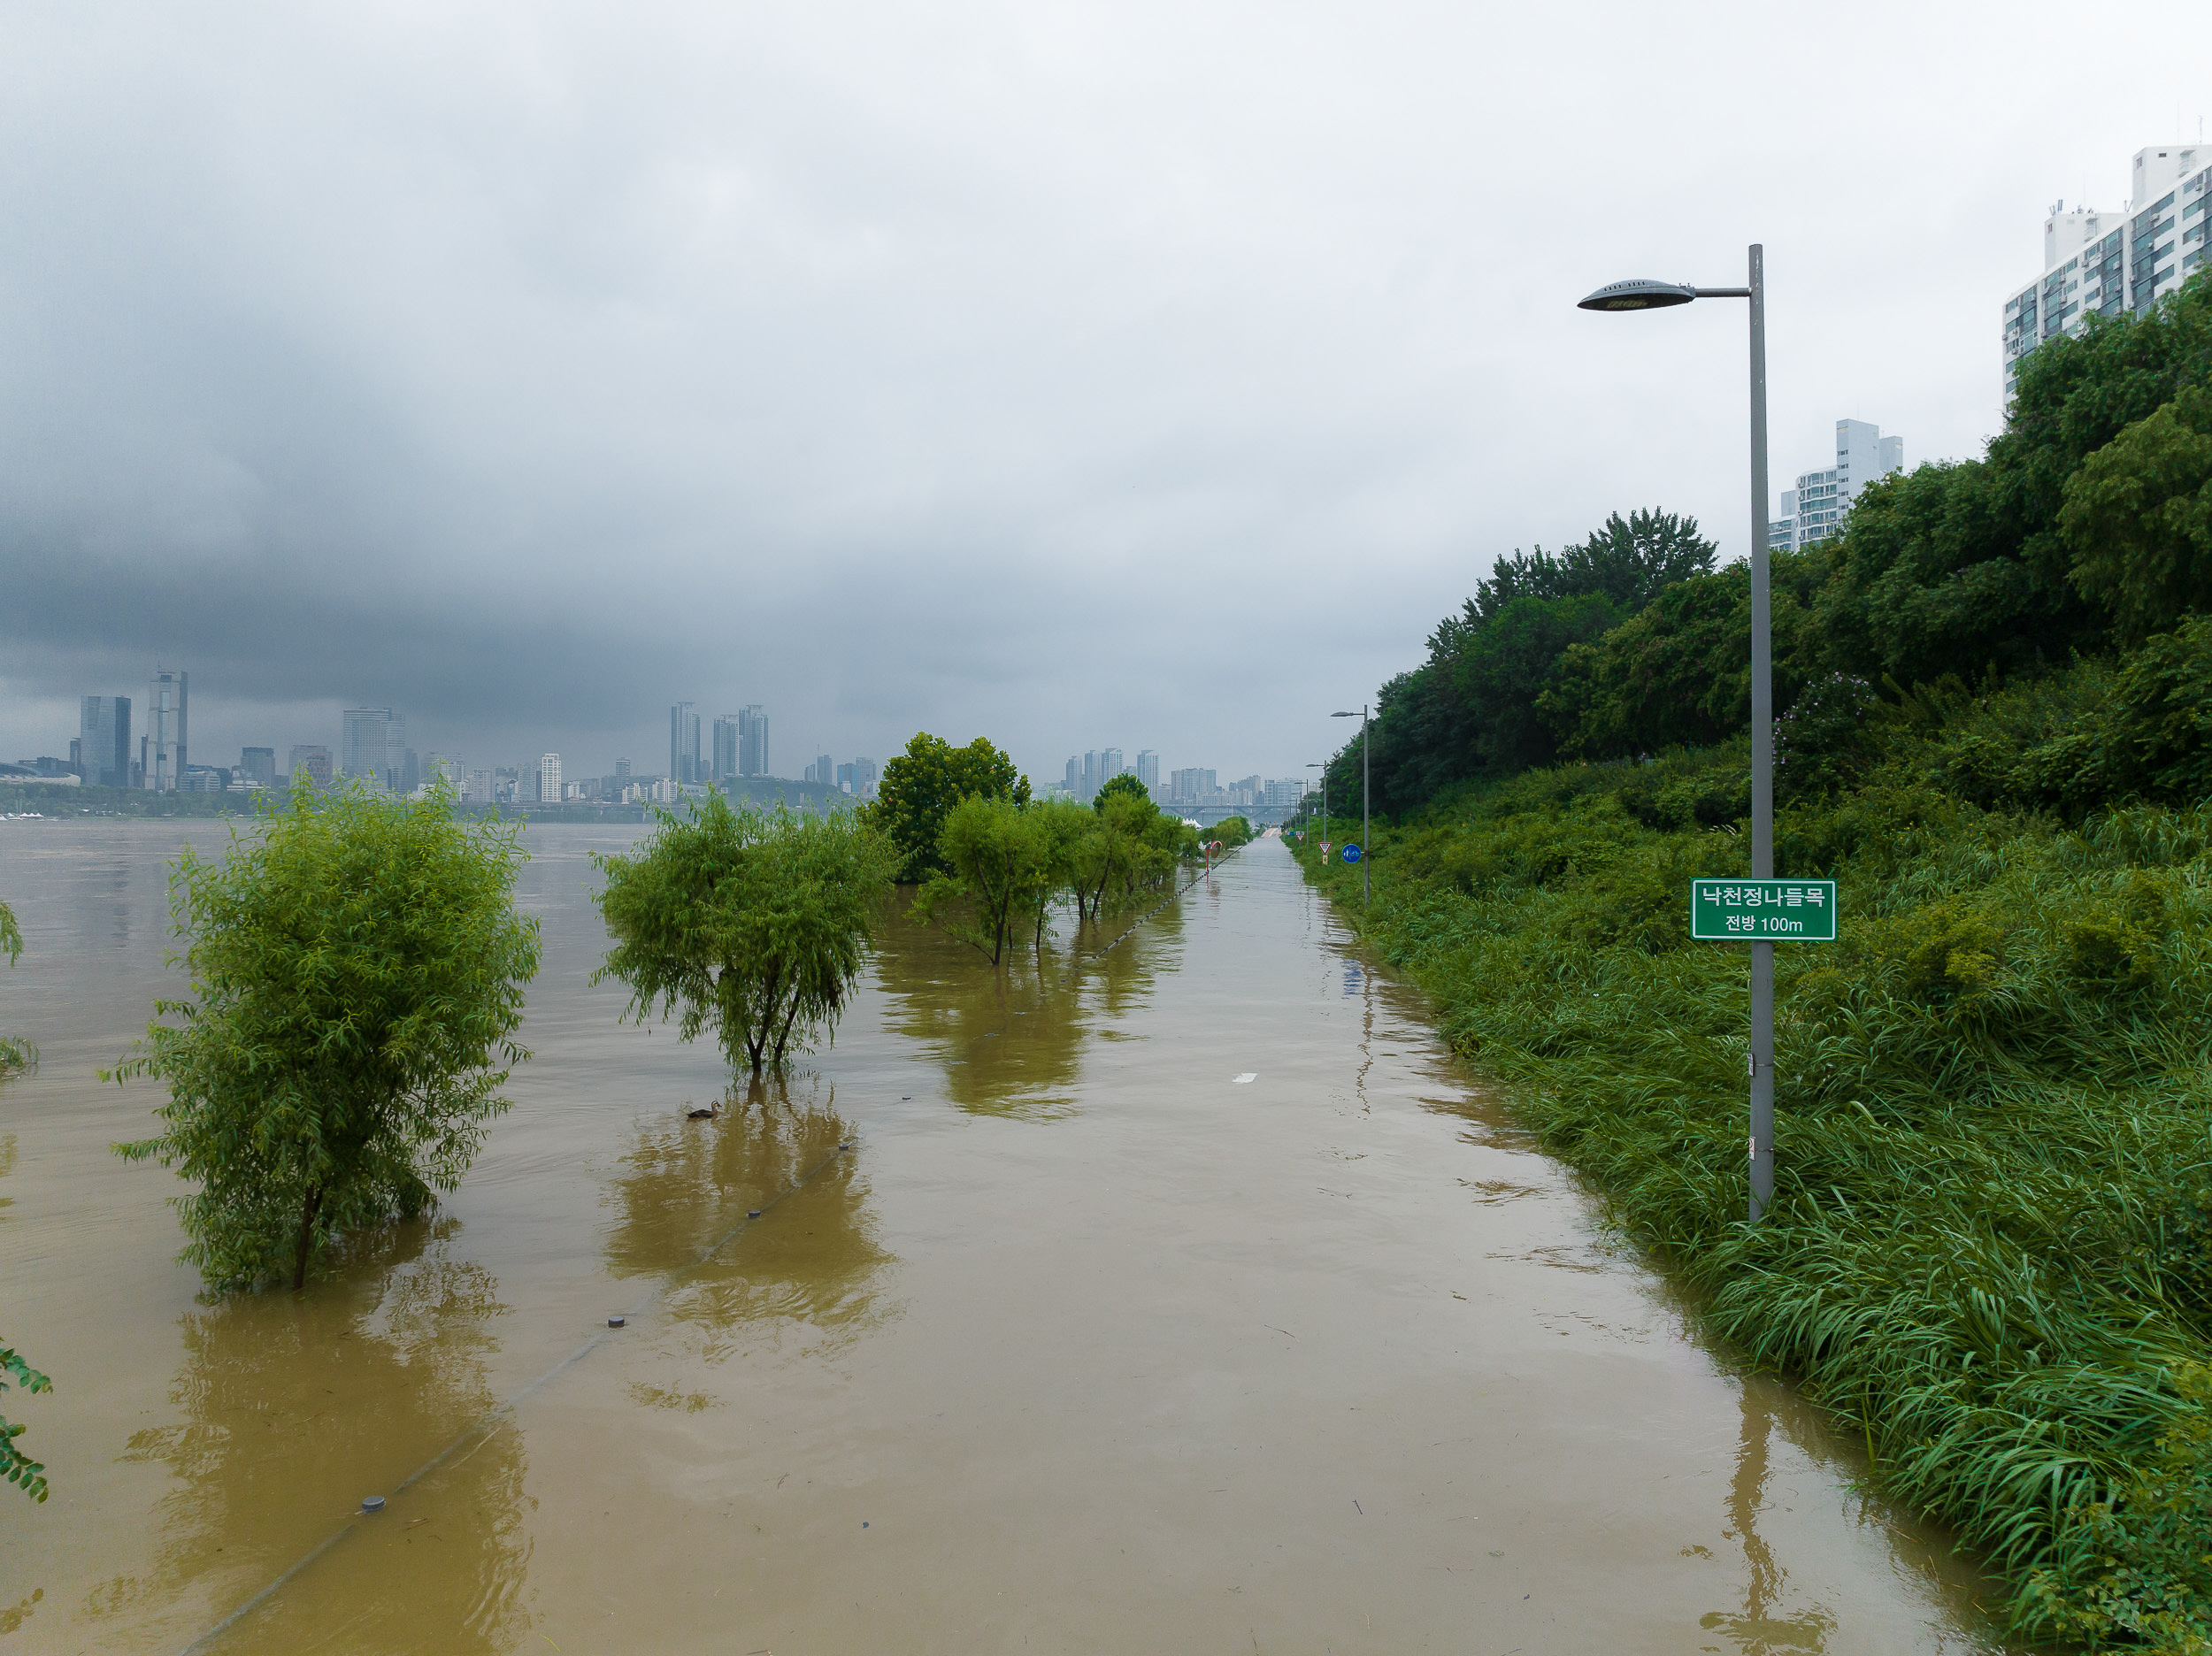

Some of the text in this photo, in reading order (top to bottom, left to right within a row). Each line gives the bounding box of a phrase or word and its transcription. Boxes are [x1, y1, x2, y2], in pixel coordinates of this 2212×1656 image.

[1702, 886, 1825, 907] 낙천정나들목
[1725, 915, 1803, 932] 전방 100m
